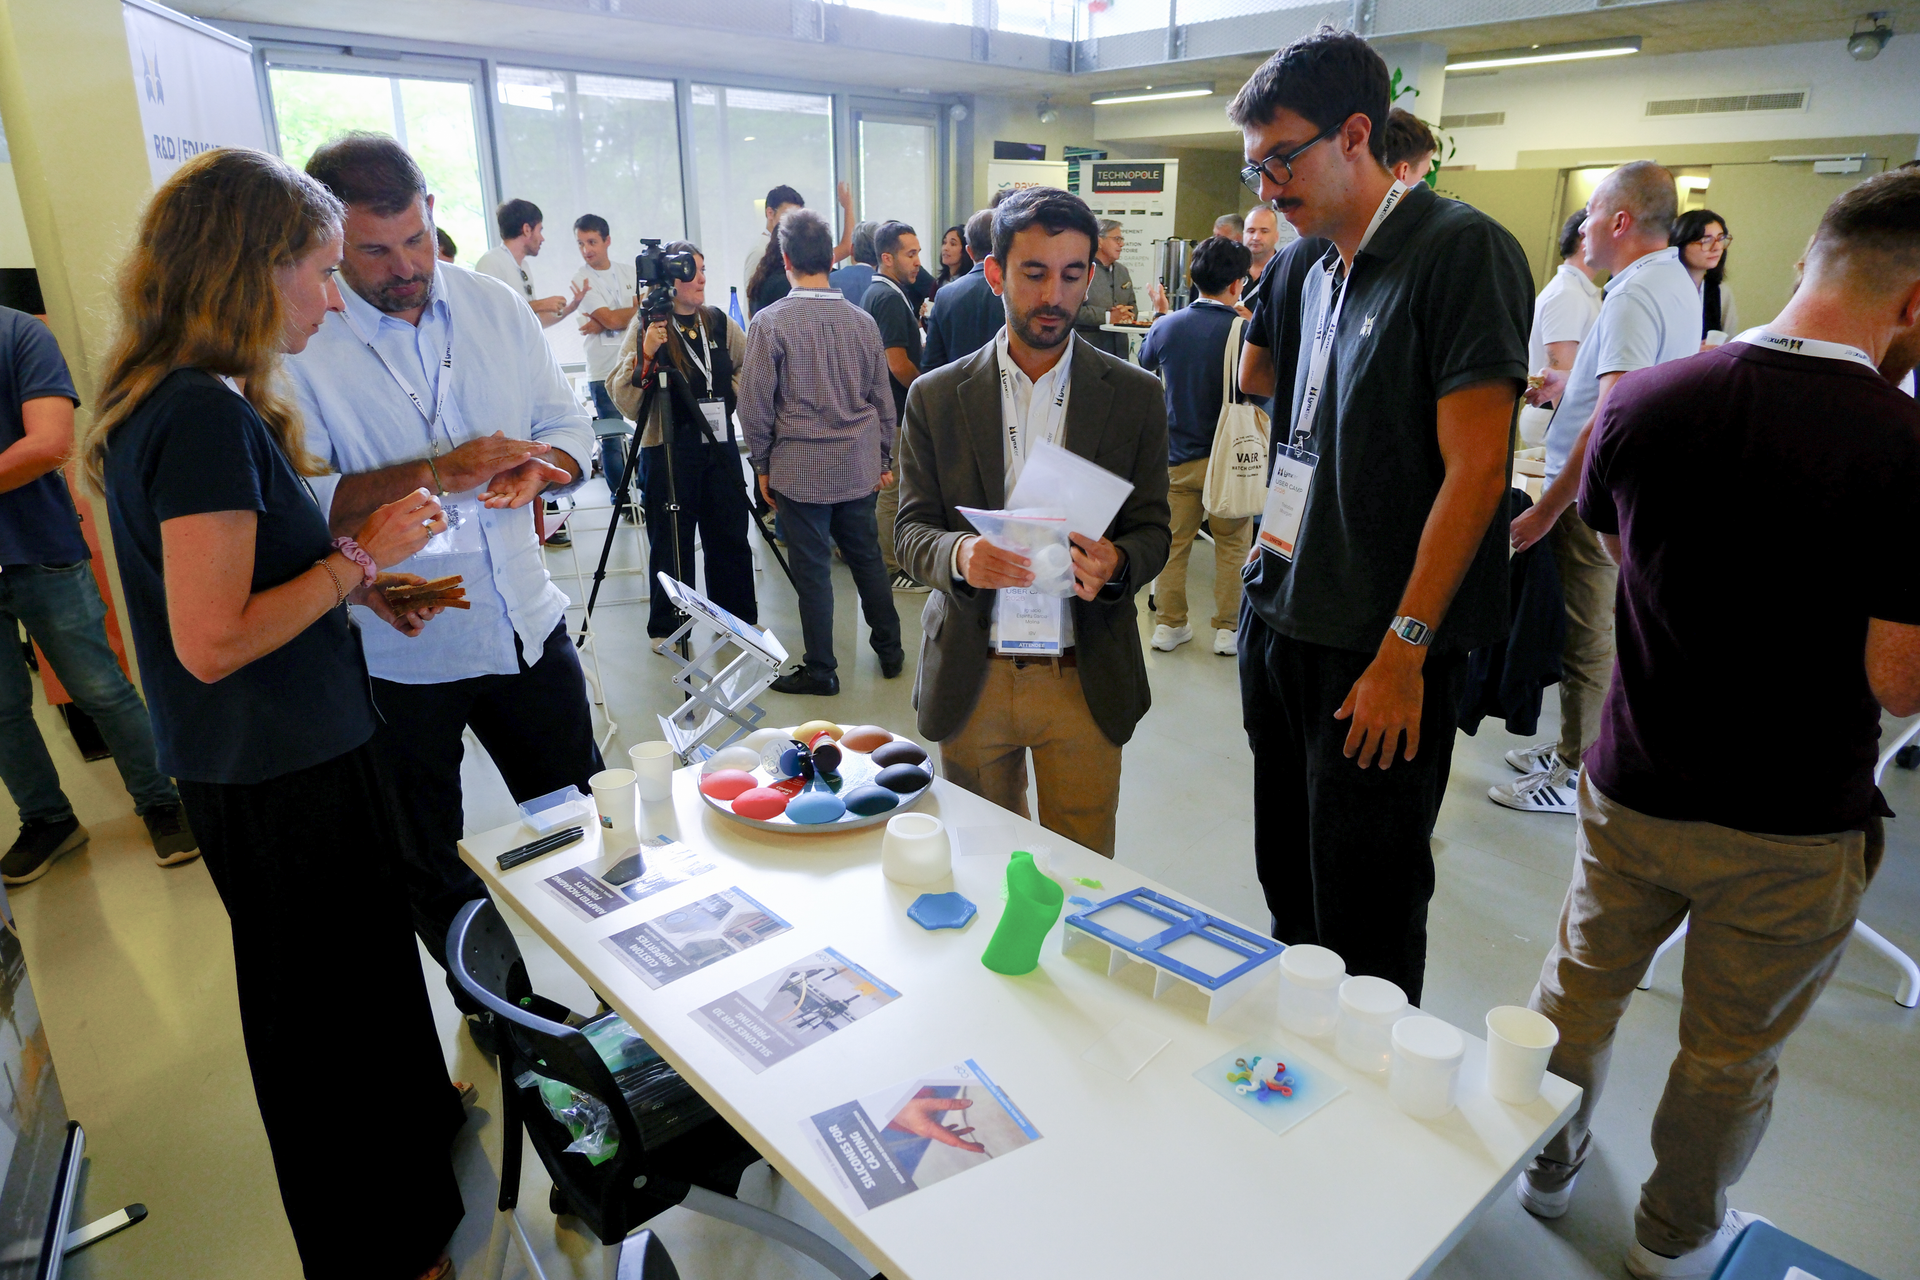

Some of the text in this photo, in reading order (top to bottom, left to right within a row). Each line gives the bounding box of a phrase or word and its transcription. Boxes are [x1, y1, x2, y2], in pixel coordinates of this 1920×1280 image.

[153, 134, 175, 159] R&D
[1097, 170, 1160, 180] TECHNOPOLE
[550, 875, 606, 914] ADAPTED PACKAGING
[574, 881, 602, 900] FORMATS
[629, 944, 659, 966] CUSTOM
[635, 934, 676, 966] PROPERTIES
[711, 1007, 773, 1056] SILICONES FOR 3D
[734, 1012, 770, 1039] PRINTING
[828, 1124, 876, 1188] SILICONES FOR
[849, 1131, 881, 1169] CASTING
